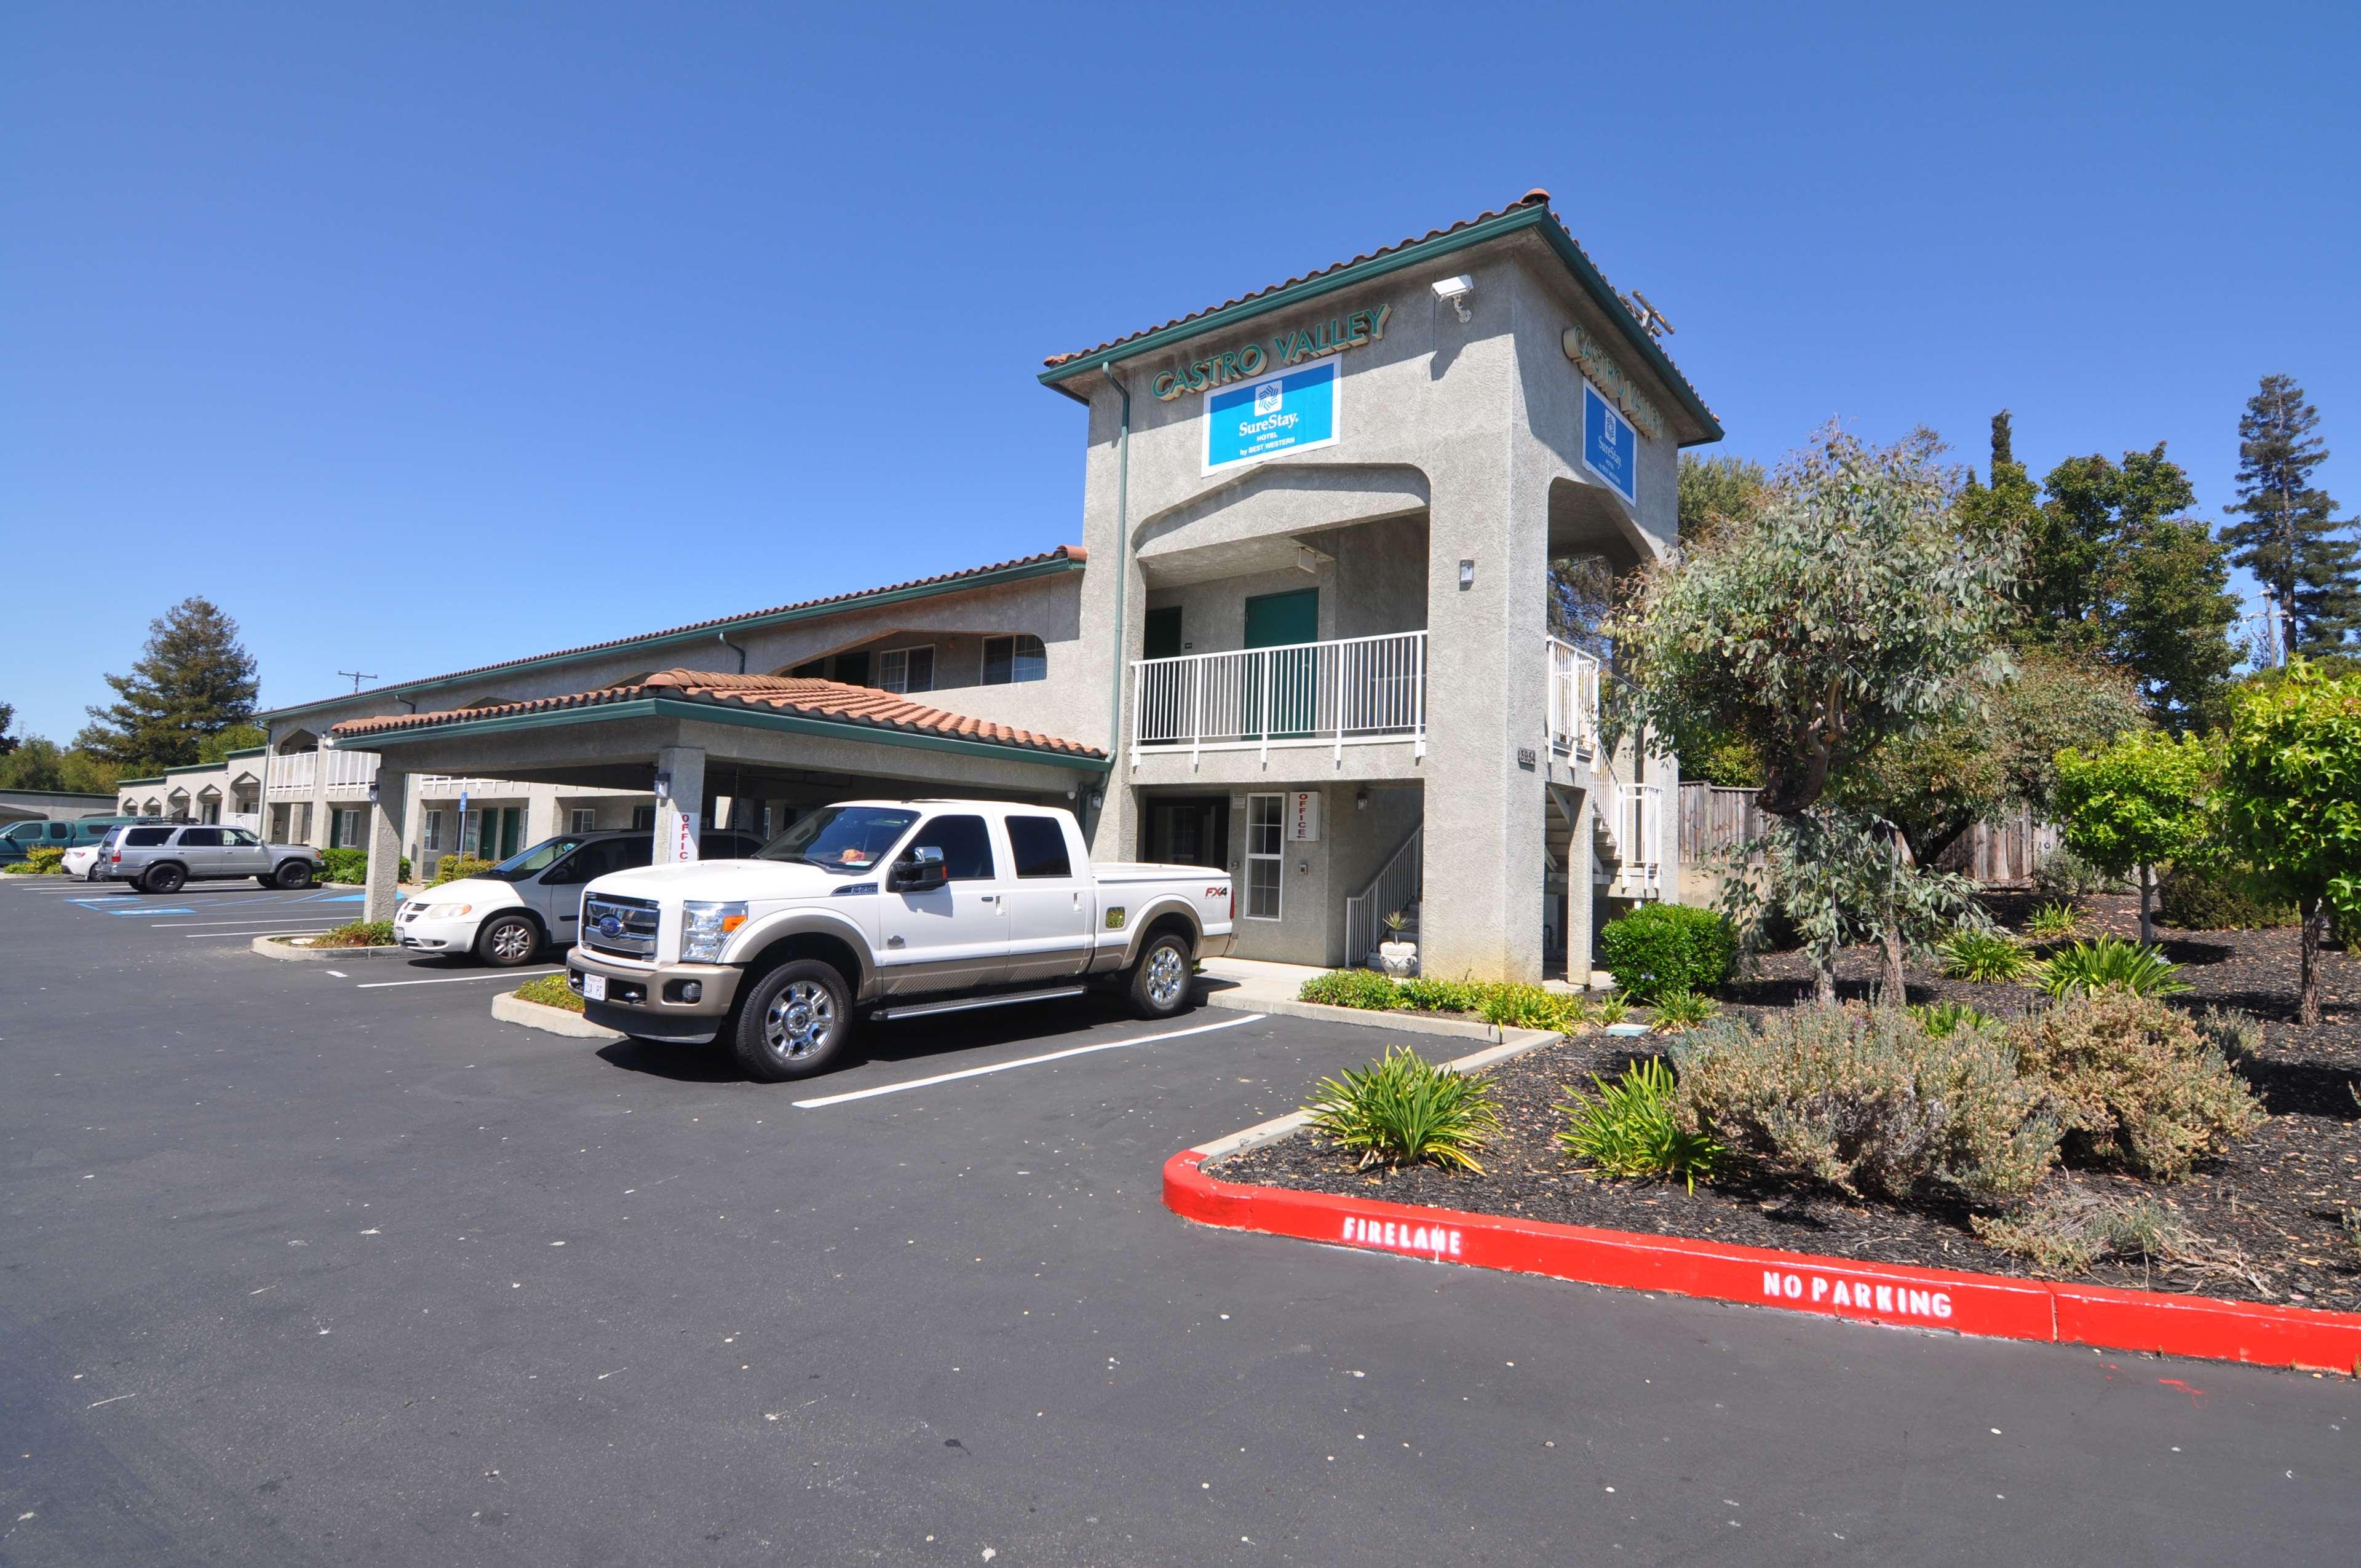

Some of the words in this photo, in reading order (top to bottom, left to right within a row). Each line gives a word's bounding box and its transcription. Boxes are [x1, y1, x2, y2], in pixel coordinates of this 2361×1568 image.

[1151, 344, 1267, 401] CASTRO
[1273, 304, 1391, 364] VALLEY
[1566, 325, 1624, 397] CASTRO
[1248, 443, 1264, 453] BEST
[1265, 436, 1295, 449] WESTERN
[1256, 432, 1278, 442] HOTEL
[1298, 793, 1309, 836] OFFICE
[680, 814, 689, 861] OFFIC
[1205, 887, 1228, 897] FX4
[1763, 1270, 1802, 1298] NO
[1812, 1277, 1952, 1318] PARKING
